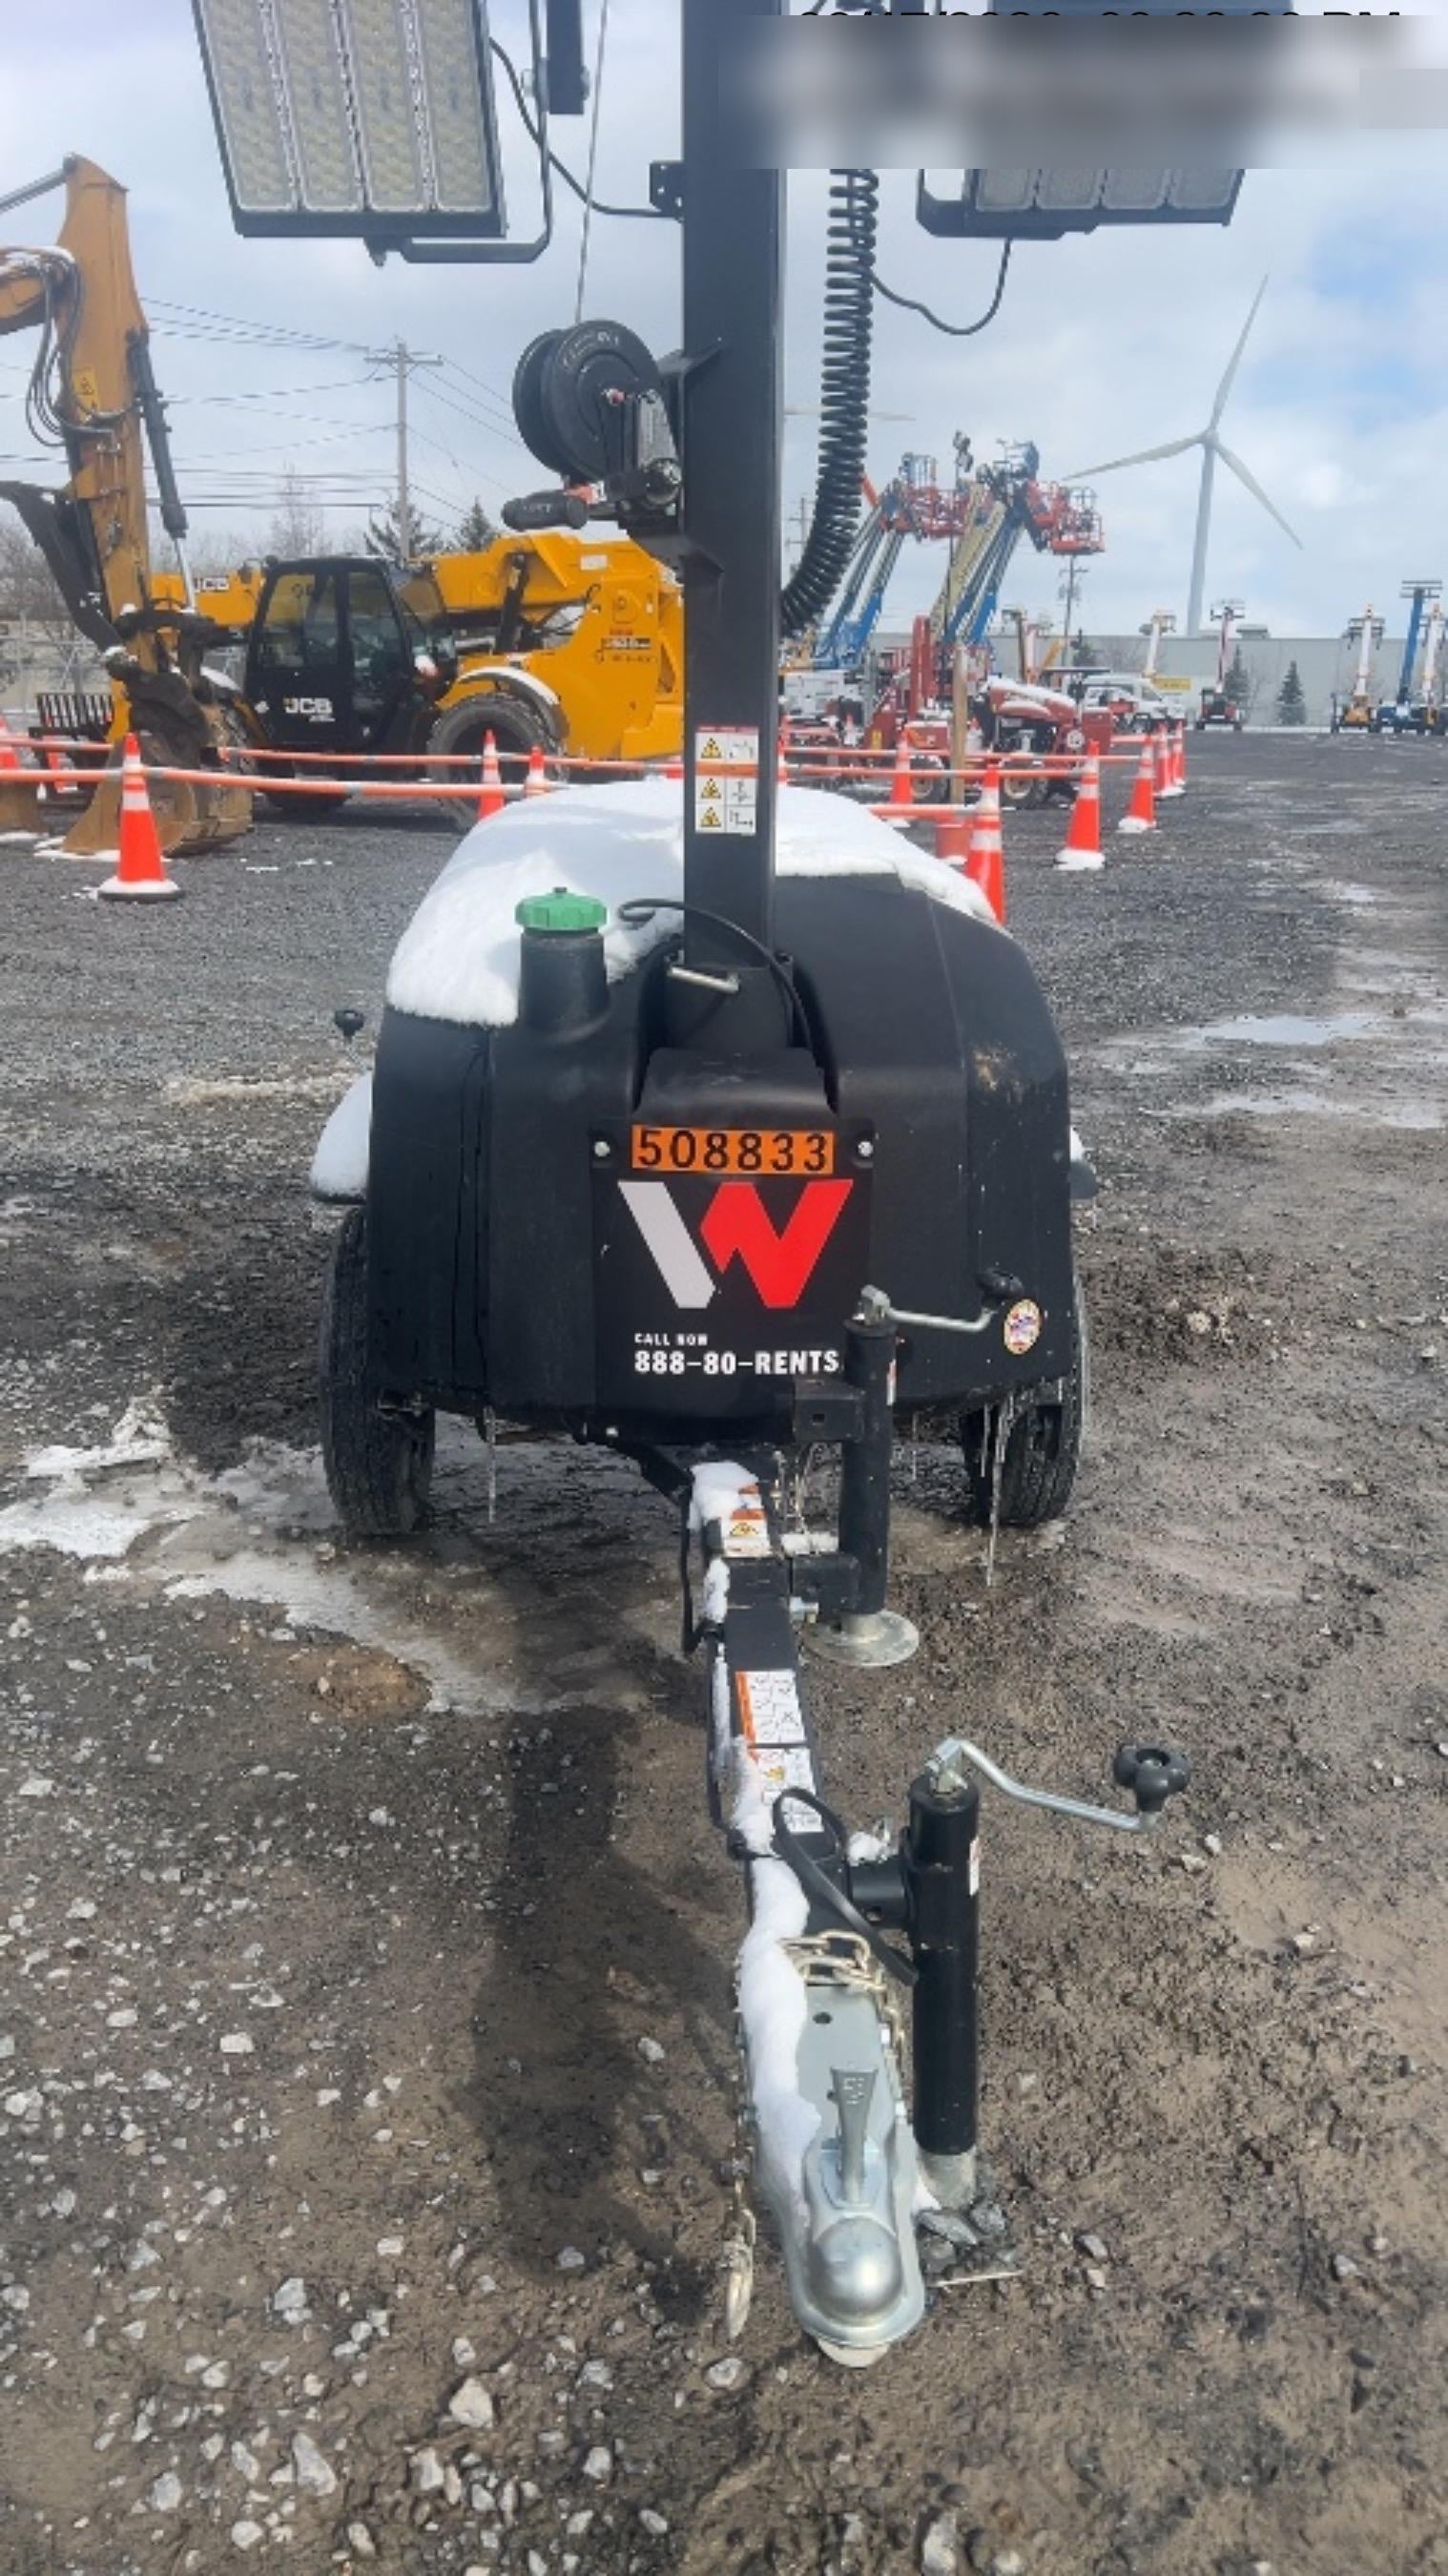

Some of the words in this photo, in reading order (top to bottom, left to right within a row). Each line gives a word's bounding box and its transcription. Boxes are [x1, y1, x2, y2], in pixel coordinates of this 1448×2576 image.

[282, 696, 333, 715] JCB
[638, 1129, 827, 1172] 508833
[634, 1333, 671, 1346] CALL
[676, 1333, 708, 1346] NOW
[634, 1349, 839, 1375] 888-80-RENTS
